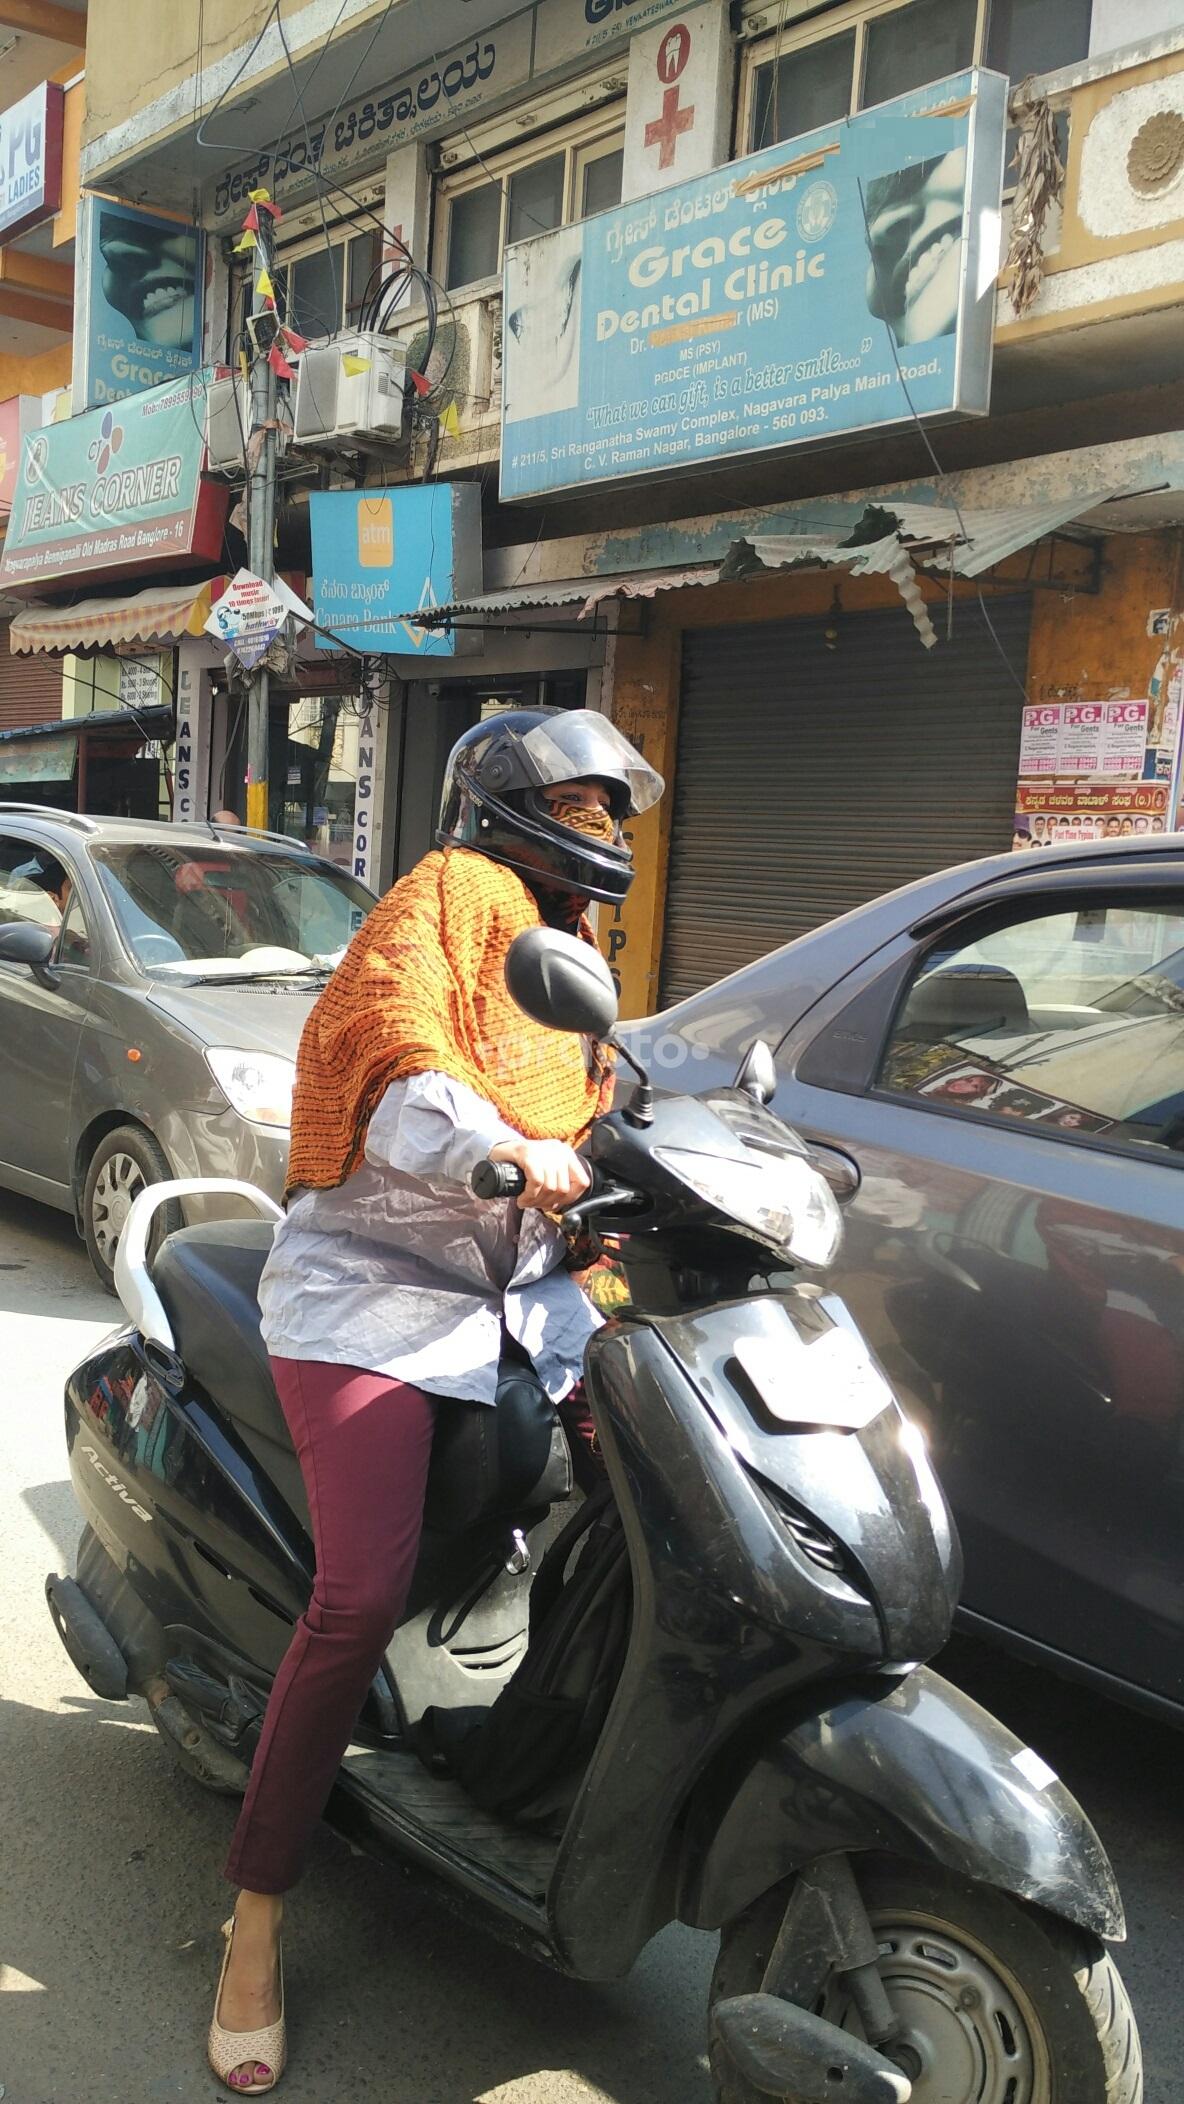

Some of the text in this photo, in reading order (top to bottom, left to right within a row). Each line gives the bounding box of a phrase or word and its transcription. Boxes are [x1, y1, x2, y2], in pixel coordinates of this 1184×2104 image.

[9, 114, 41, 179] PG
[8, 165, 40, 204] LADIES
[628, 218, 788, 288] Grace
[596, 278, 711, 341] Dental
[724, 249, 825, 301] Clinic
[630, 298, 779, 355] Dr. (MS)
[679, 339, 721, 362] MS (PSY)
[654, 352, 748, 386] PGDCE (IMPLANT)
[629, 399, 649, 420] we
[650, 393, 677, 416] can
[713, 375, 729, 401] is
[730, 377, 742, 397] a
[744, 363, 793, 394] better
[551, 445, 566, 461] Sri
[568, 431, 633, 457] Ranganatha
[635, 420, 678, 441] Swamy
[681, 408, 740, 431] Complex,
[743, 393, 807, 417] Nagavara
[811, 383, 851, 407] Palya
[855, 370, 891, 392] Main
[611, 444, 651, 464] Raman
[654, 435, 691, 456] Nagar,
[695, 422, 760, 447] Bangalore
[772, 414, 797, 432] 560
[800, 406, 829, 425] 093.
[19, 456, 182, 541] JEANS CORNER
[82, 541, 94, 558] Old
[93, 537, 118, 555] Madras
[118, 531, 137, 550] Road
[136, 526, 169, 548] Banglore
[174, 520, 184, 539] 16
[362, 524, 391, 544] atm
[232, 580, 263, 592] Download
[240, 589, 260, 598] music
[236, 597, 254, 606] times
[315, 607, 397, 634] Canara Bank
[1024, 709, 1059, 727] P.G.
[1064, 706, 1100, 724] P.G.
[1107, 704, 1144, 723] P.G.
[1125, 724, 1144, 732] Gents
[1040, 727, 1058, 735] Gents
[1080, 725, 1099, 733] Gents
[81, 1446, 153, 1522] Activa
